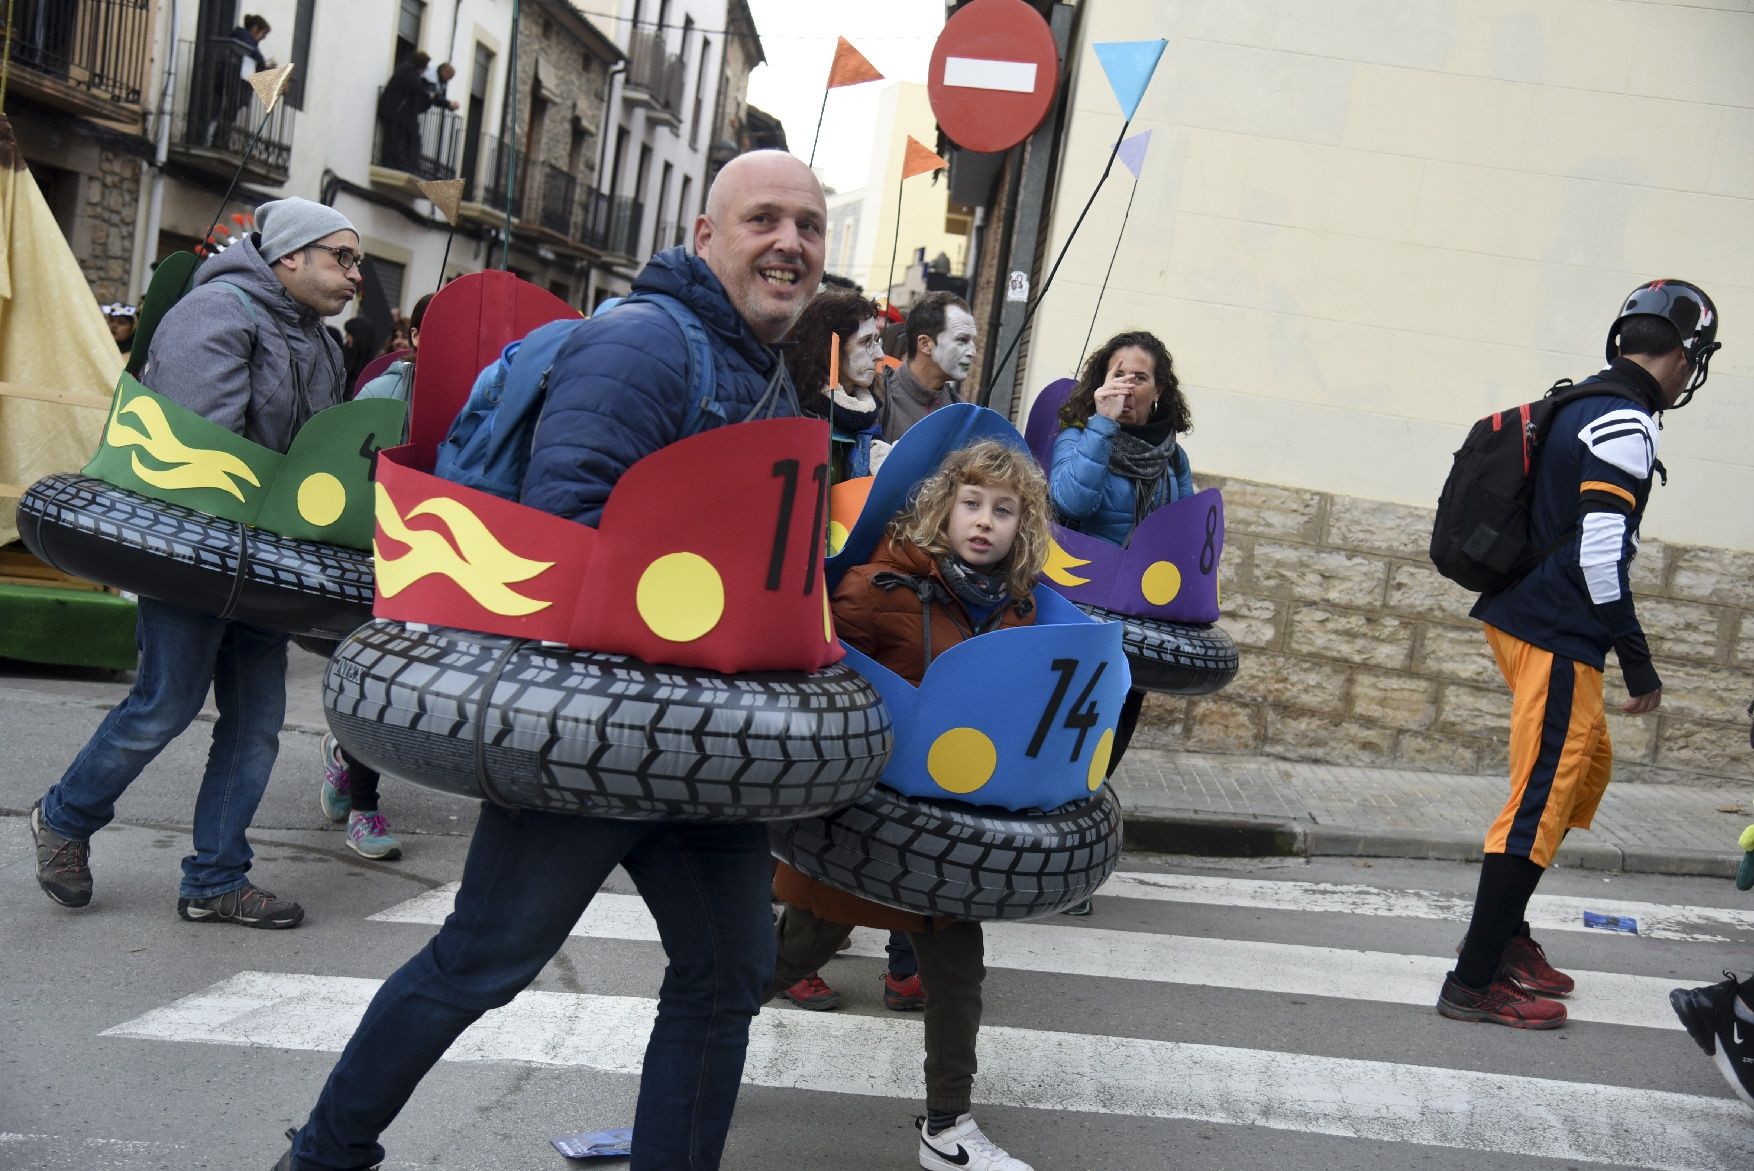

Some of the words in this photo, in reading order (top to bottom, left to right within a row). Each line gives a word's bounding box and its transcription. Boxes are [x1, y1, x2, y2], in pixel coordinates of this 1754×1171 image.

[765, 458, 828, 596] 11
[1200, 504, 1217, 575] 8
[1025, 658, 1108, 763] 14
